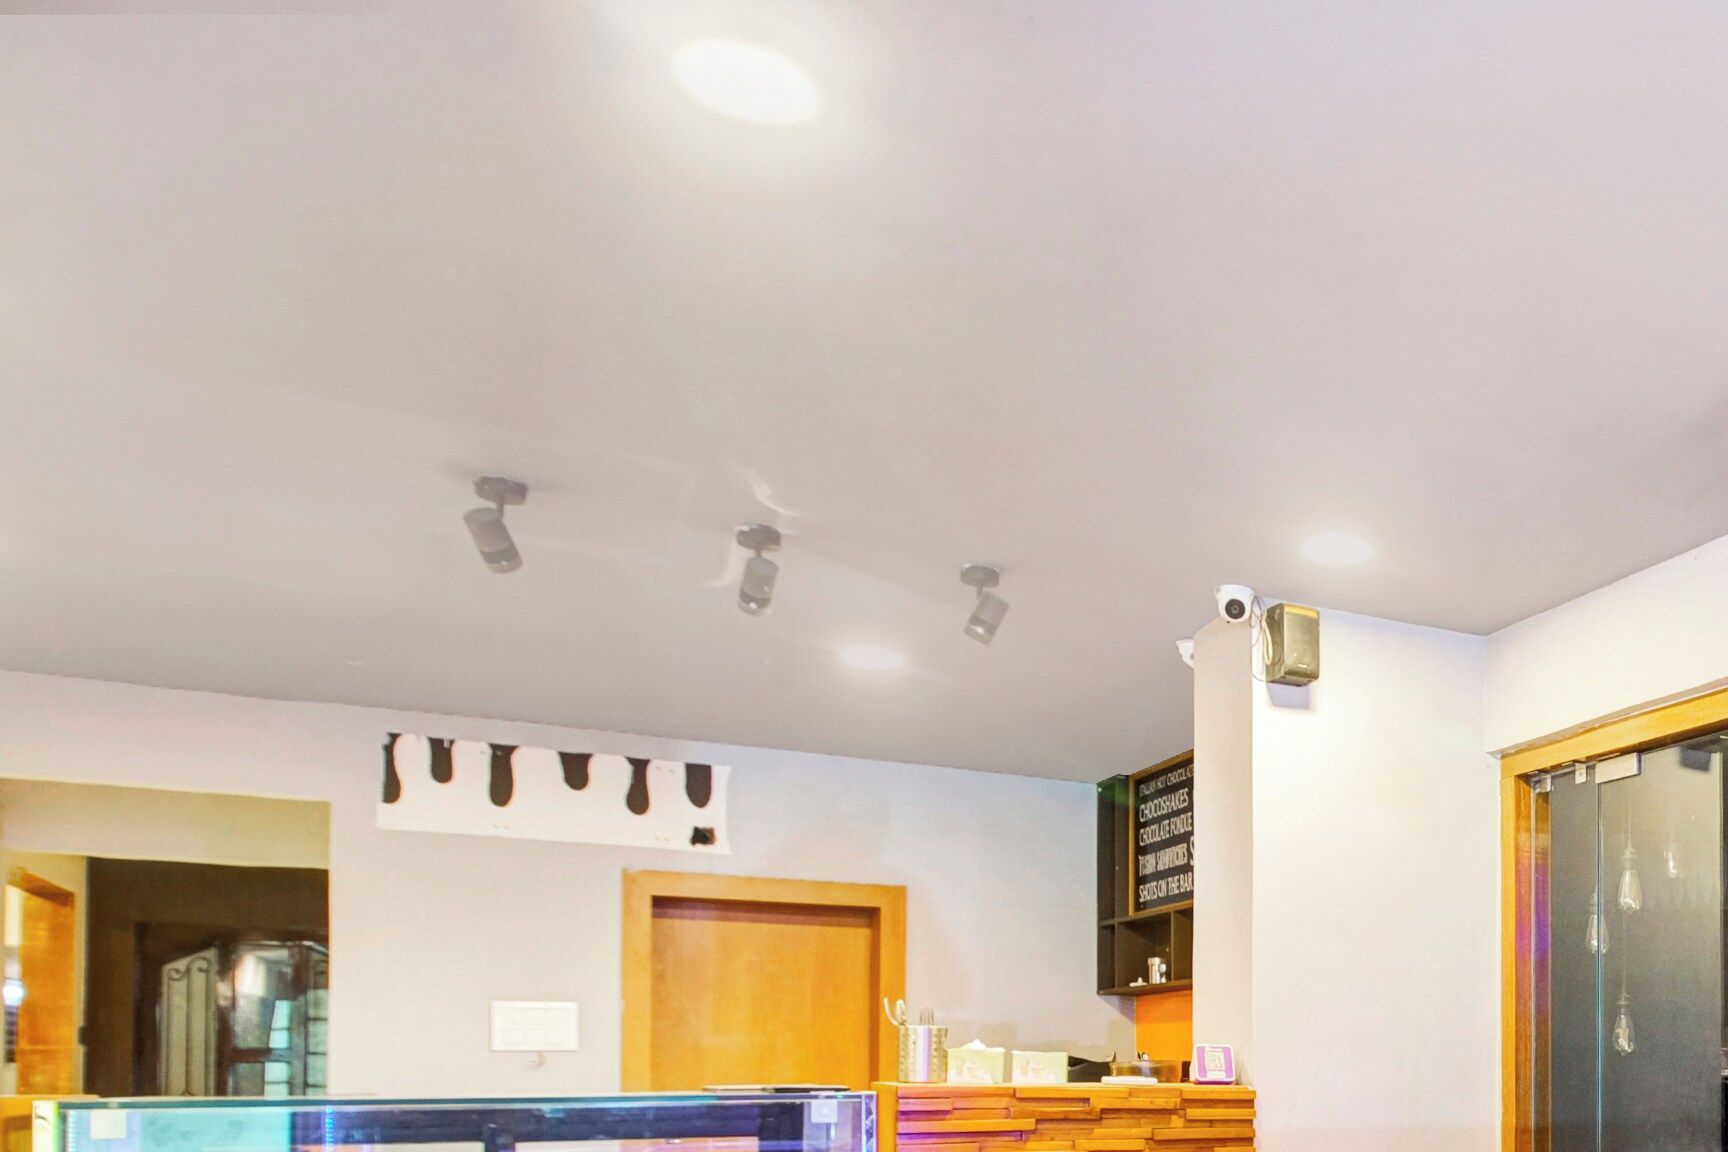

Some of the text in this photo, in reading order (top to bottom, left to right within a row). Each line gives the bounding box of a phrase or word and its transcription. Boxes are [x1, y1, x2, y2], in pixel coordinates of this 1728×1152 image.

[1139, 787, 1189, 822] CHOCOSHAKES
[1139, 819, 1170, 847] CHOCOLATE
[1139, 872, 1194, 903] SHOTS ON THE BAR
